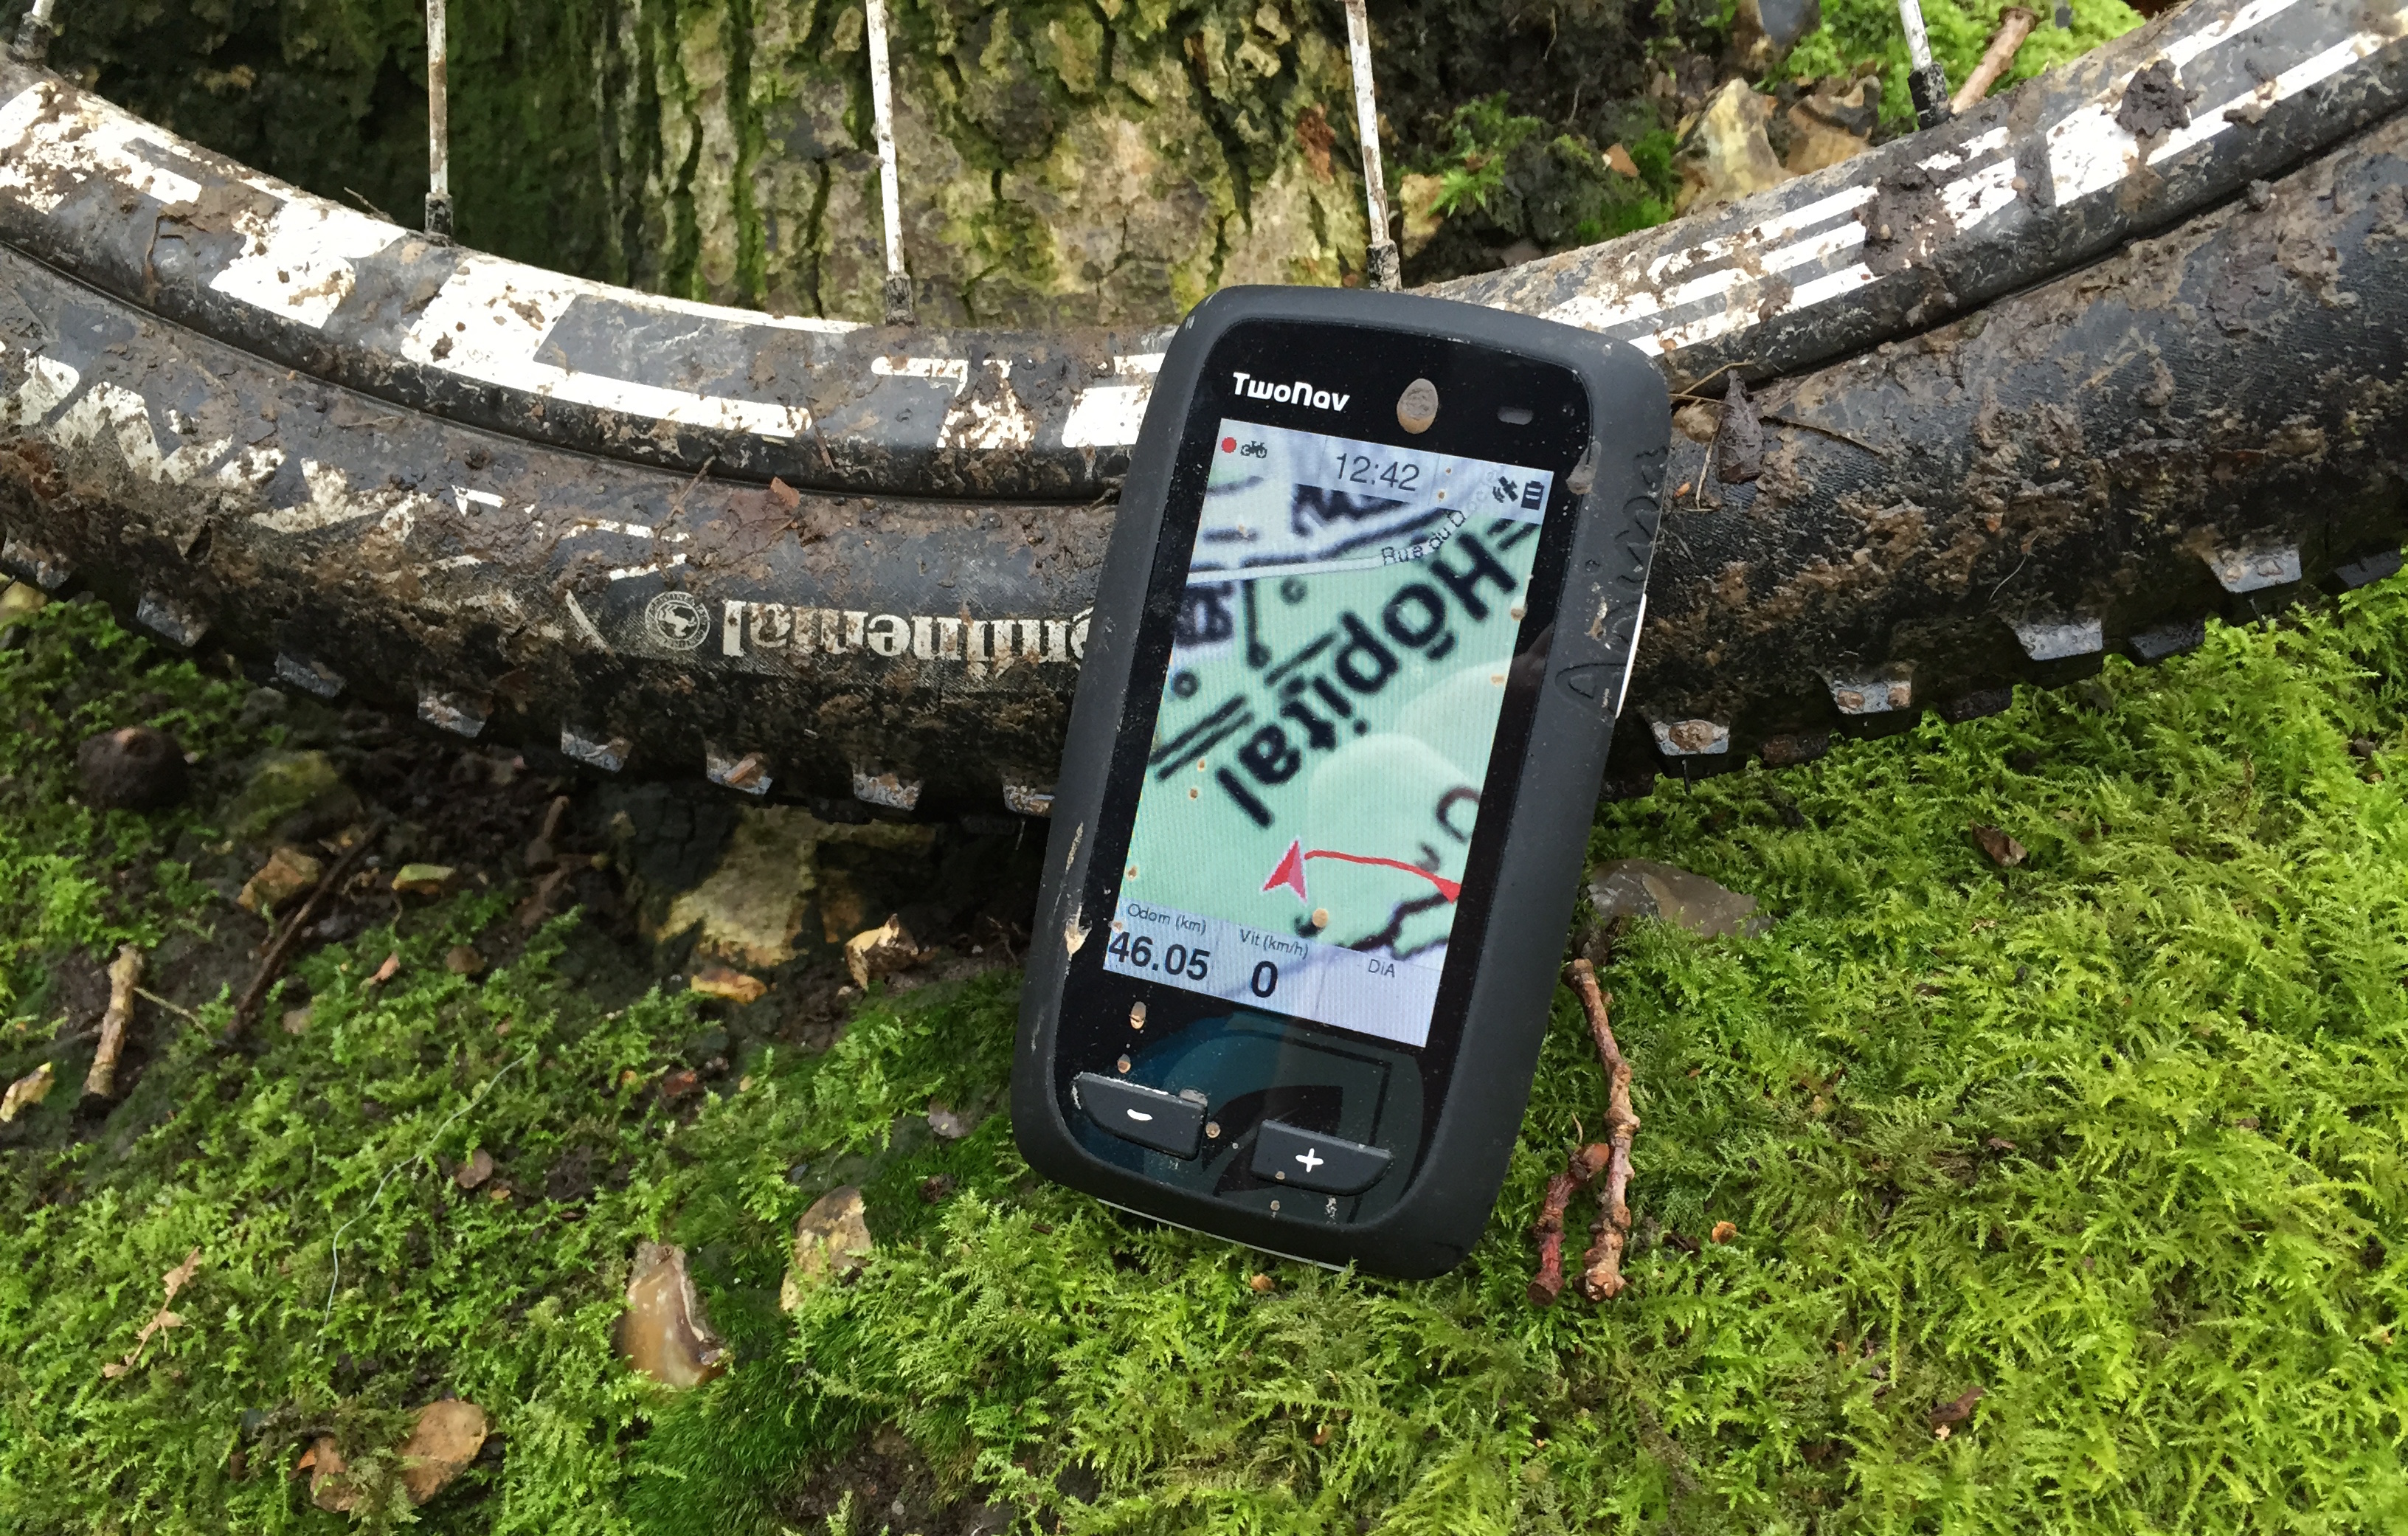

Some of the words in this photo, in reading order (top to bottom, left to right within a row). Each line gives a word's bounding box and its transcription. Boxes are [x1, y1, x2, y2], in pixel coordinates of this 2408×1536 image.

[1233, 371, 1350, 412] TwoNav
[1336, 452, 1419, 491] 12:42
[1382, 545, 1423, 566] Rue
[1429, 527, 1452, 549] du
[722, 598, 1095, 679] ontinental
[1215, 531, 1519, 829] Hôpital
[1127, 903, 1171, 926] Odom
[1174, 914, 1208, 935] (km)
[1108, 931, 1211, 981] 46.05
[1239, 928, 1261, 947] Vit
[1262, 933, 1309, 960] (km/h)
[1250, 961, 1279, 999] 0
